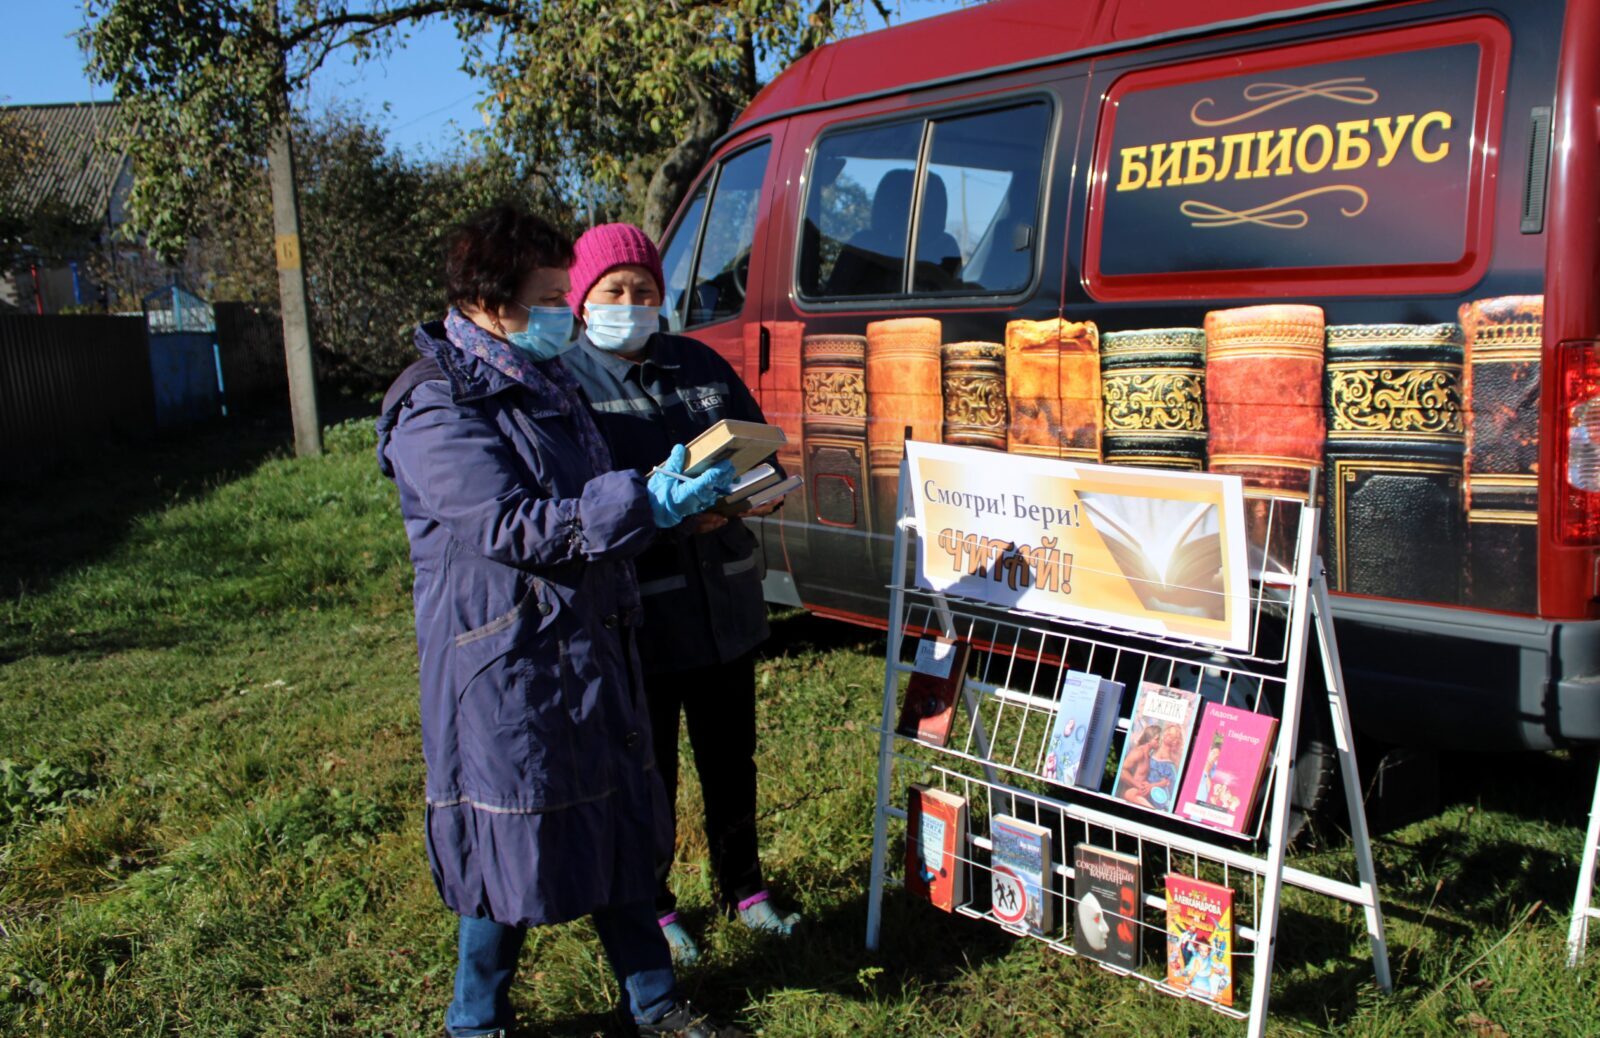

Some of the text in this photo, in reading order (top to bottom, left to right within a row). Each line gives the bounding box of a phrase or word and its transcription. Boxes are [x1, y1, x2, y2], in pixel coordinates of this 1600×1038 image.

[1115, 110, 1453, 192] БИБЛИОБУС
[924, 479, 1080, 529] Смотри! Бери!
[937, 527, 1074, 595] ЧИТАЙ!
[1228, 730, 1261, 746] Пифагор
